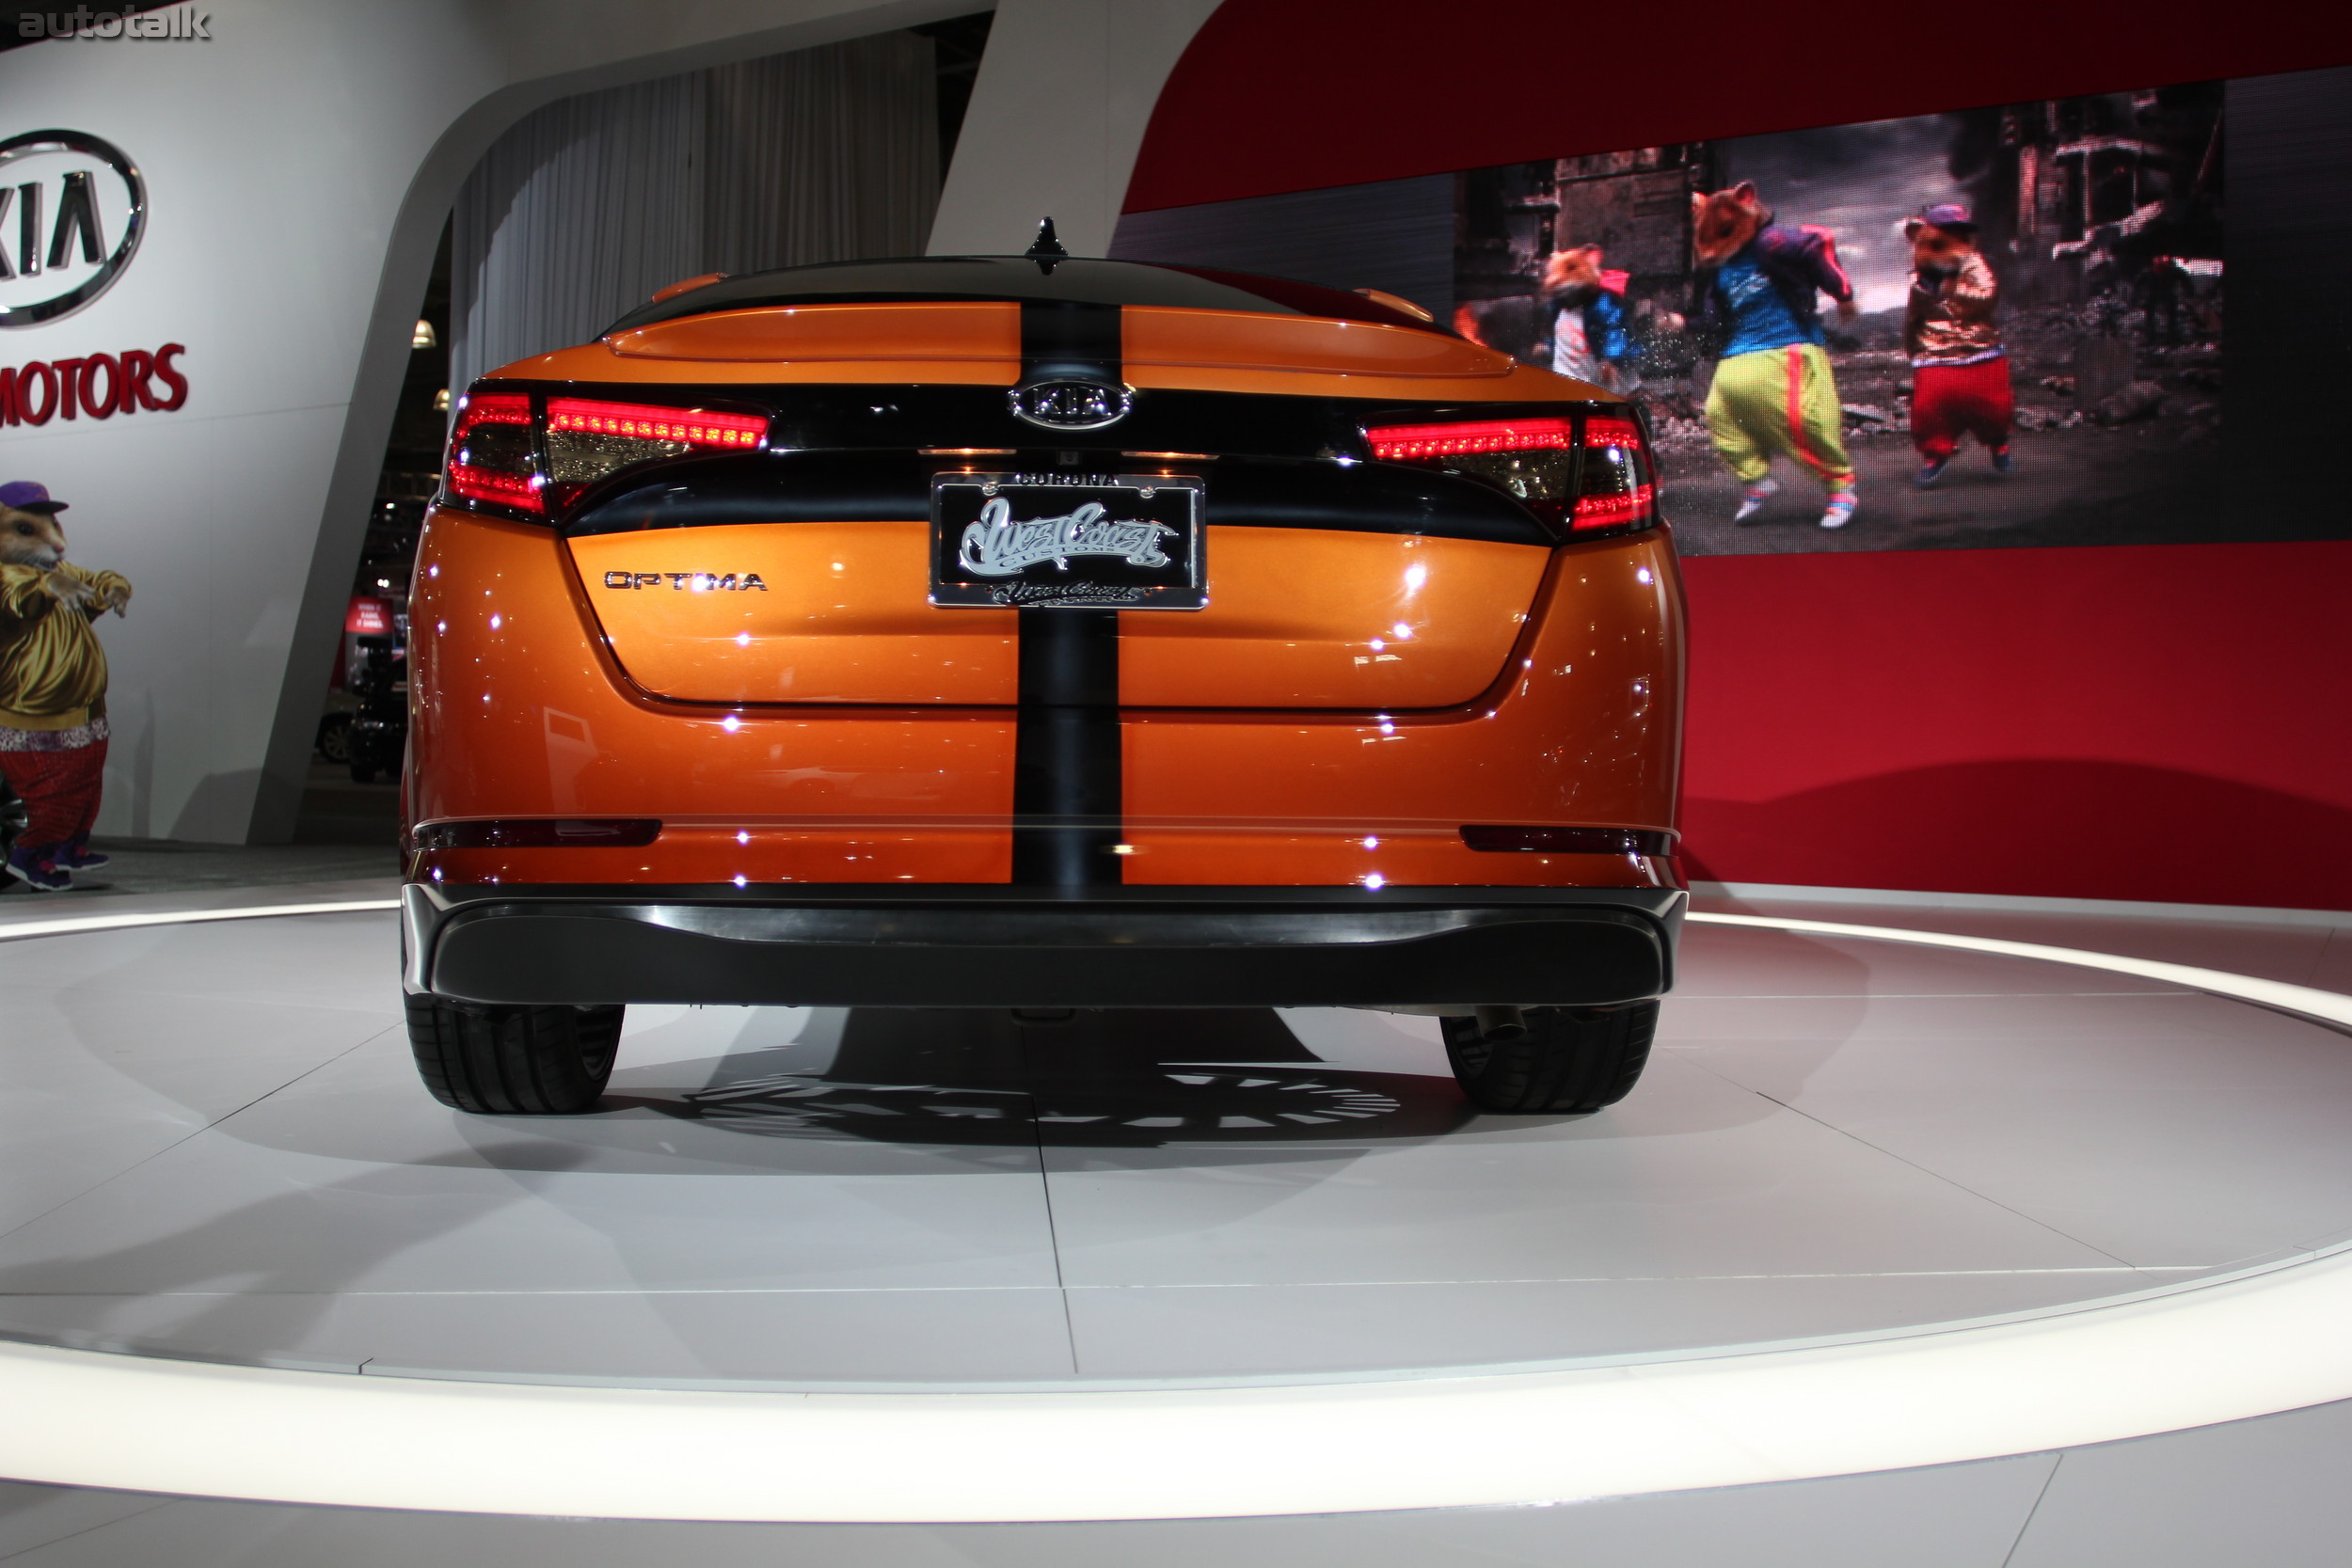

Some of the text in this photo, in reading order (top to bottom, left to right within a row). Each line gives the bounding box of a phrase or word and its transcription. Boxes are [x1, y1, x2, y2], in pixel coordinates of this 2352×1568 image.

[1033, 387, 1112, 417] KIA
[960, 497, 1179, 577] West Coast
[998, 546, 1116, 568] CUSTOMS
